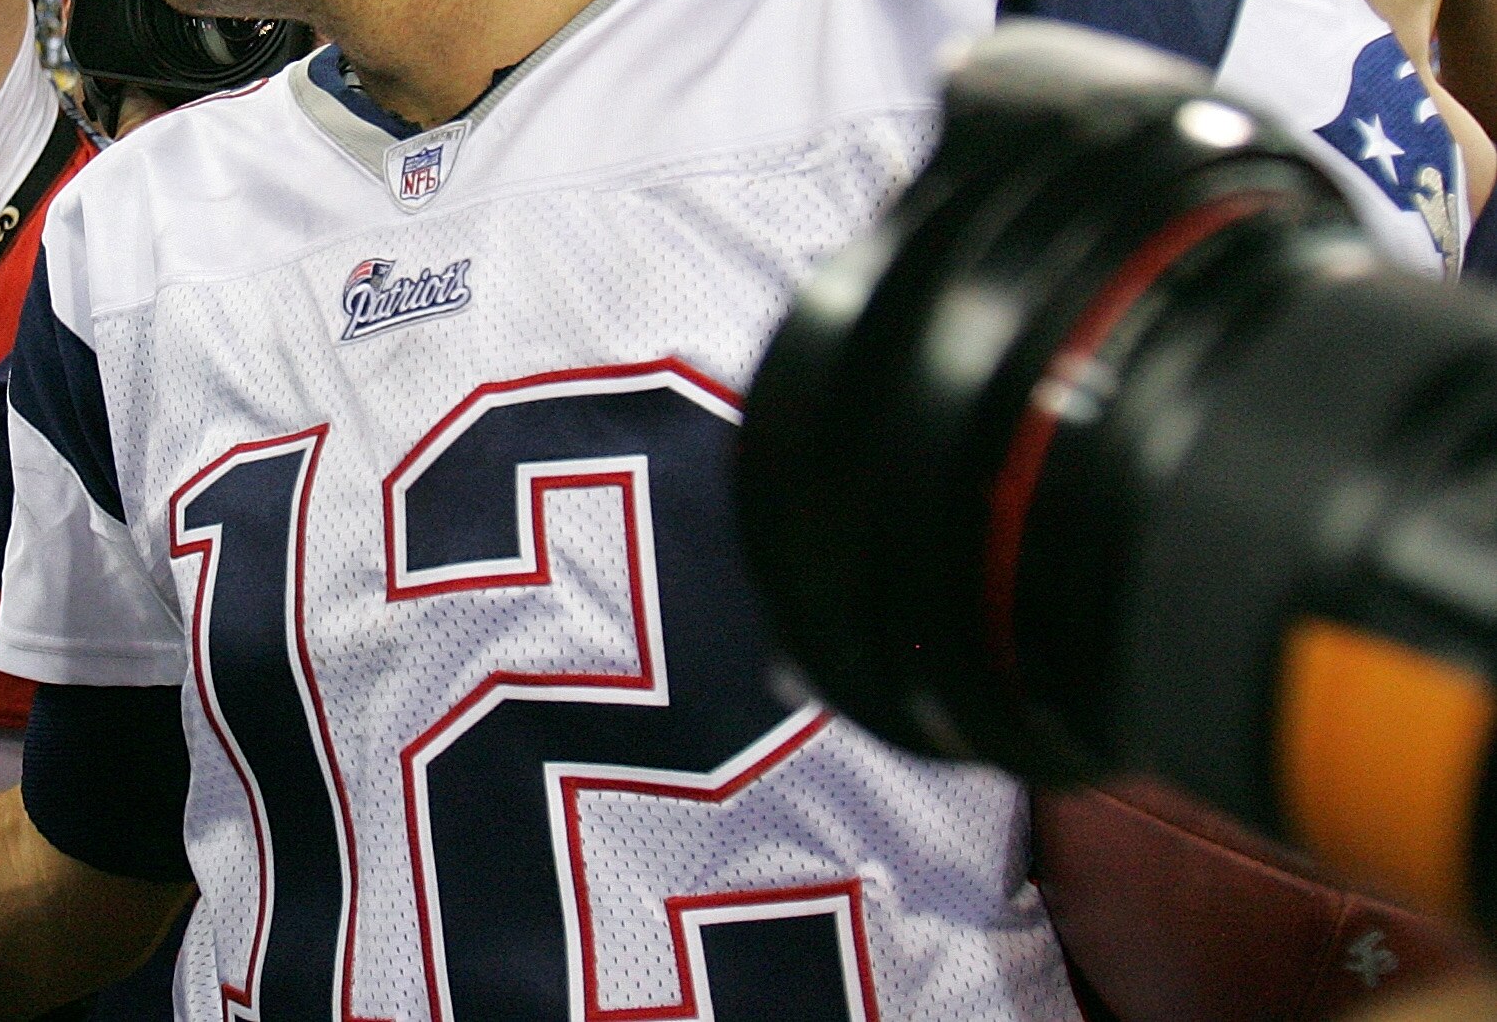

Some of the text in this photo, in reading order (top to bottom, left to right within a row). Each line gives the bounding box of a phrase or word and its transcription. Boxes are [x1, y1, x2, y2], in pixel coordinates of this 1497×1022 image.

[402, 166, 437, 196] NFL
[341, 259, 471, 340] Patriots
[170, 356, 880, 1022] 12
